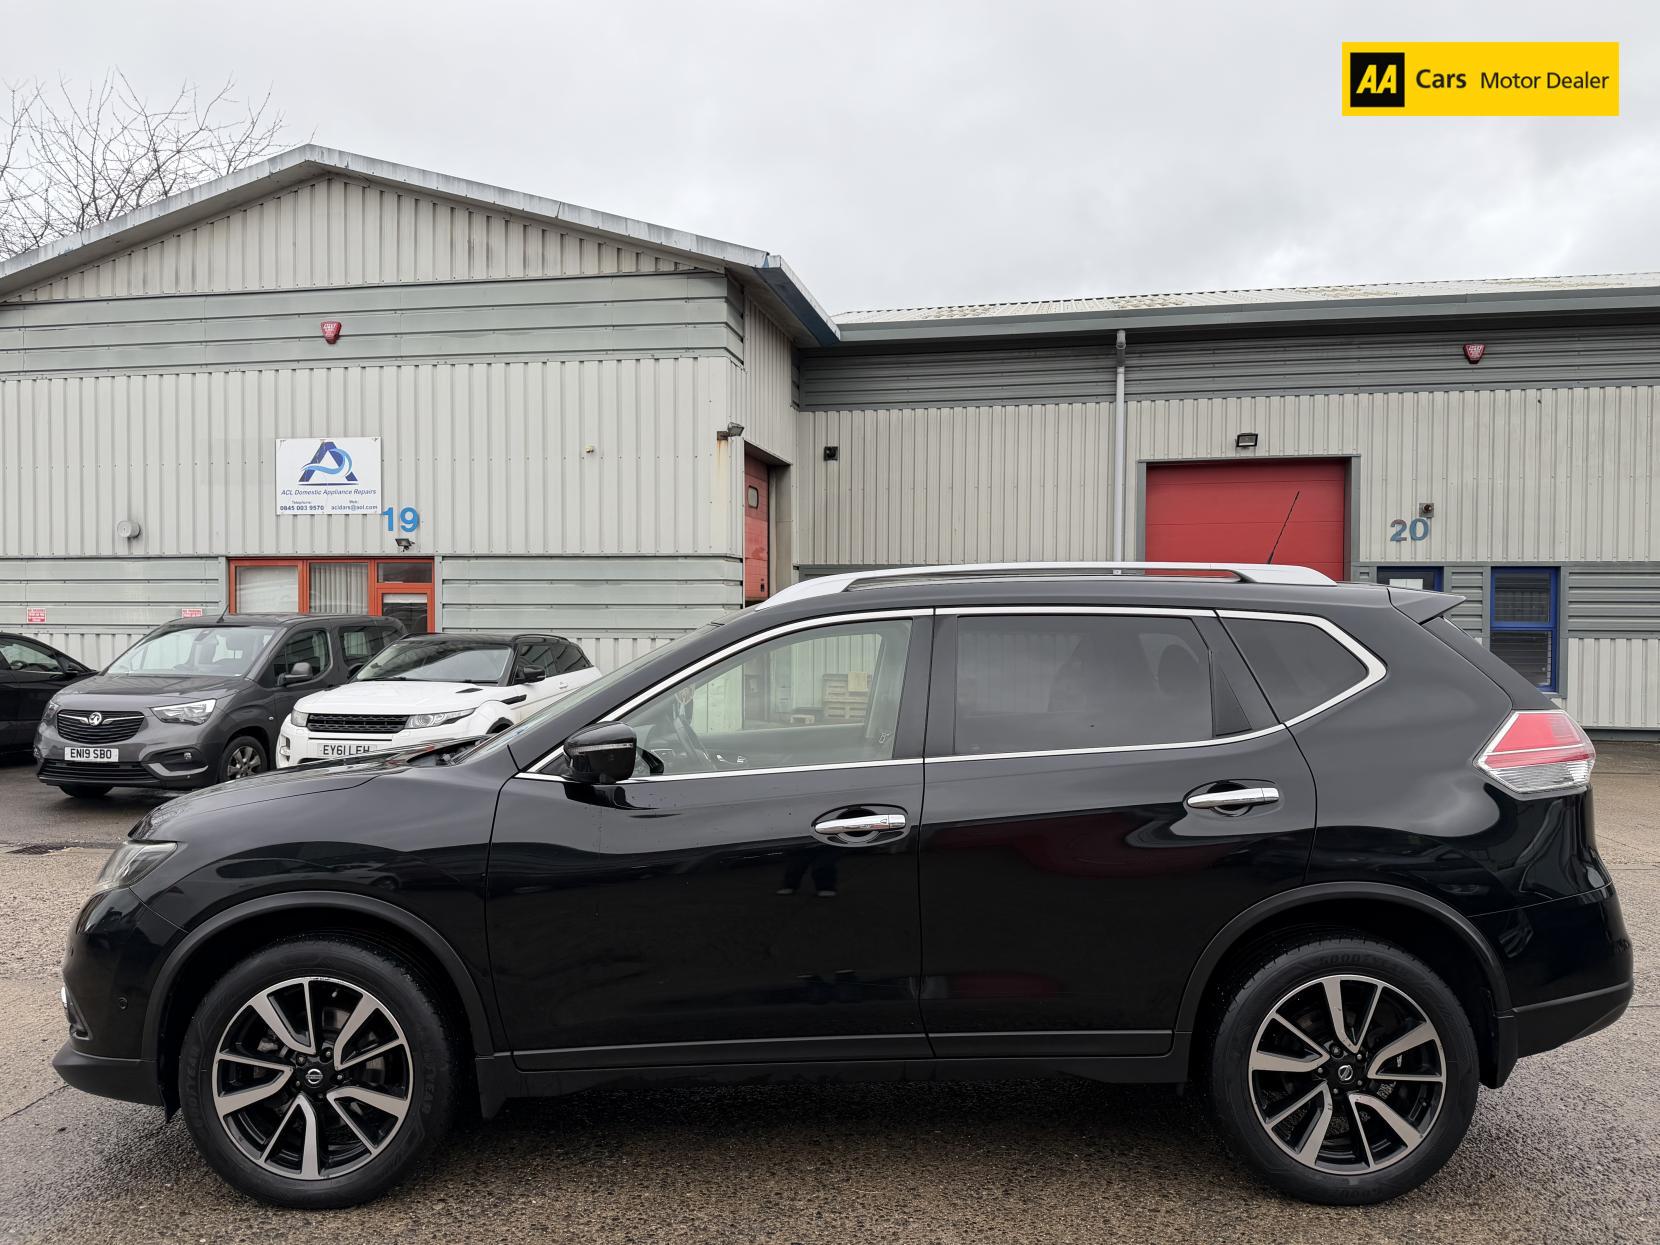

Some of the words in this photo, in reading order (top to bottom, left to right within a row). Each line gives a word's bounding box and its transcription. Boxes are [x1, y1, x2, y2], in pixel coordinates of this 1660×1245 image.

[353, 488, 377, 496] Repairs
[382, 506, 420, 533] 19
[1389, 518, 1429, 542] 20
[70, 748, 90, 759] EN19
[92, 749, 112, 760] SBO
[323, 744, 346, 755] EY61
[348, 745, 370, 755] LEH
